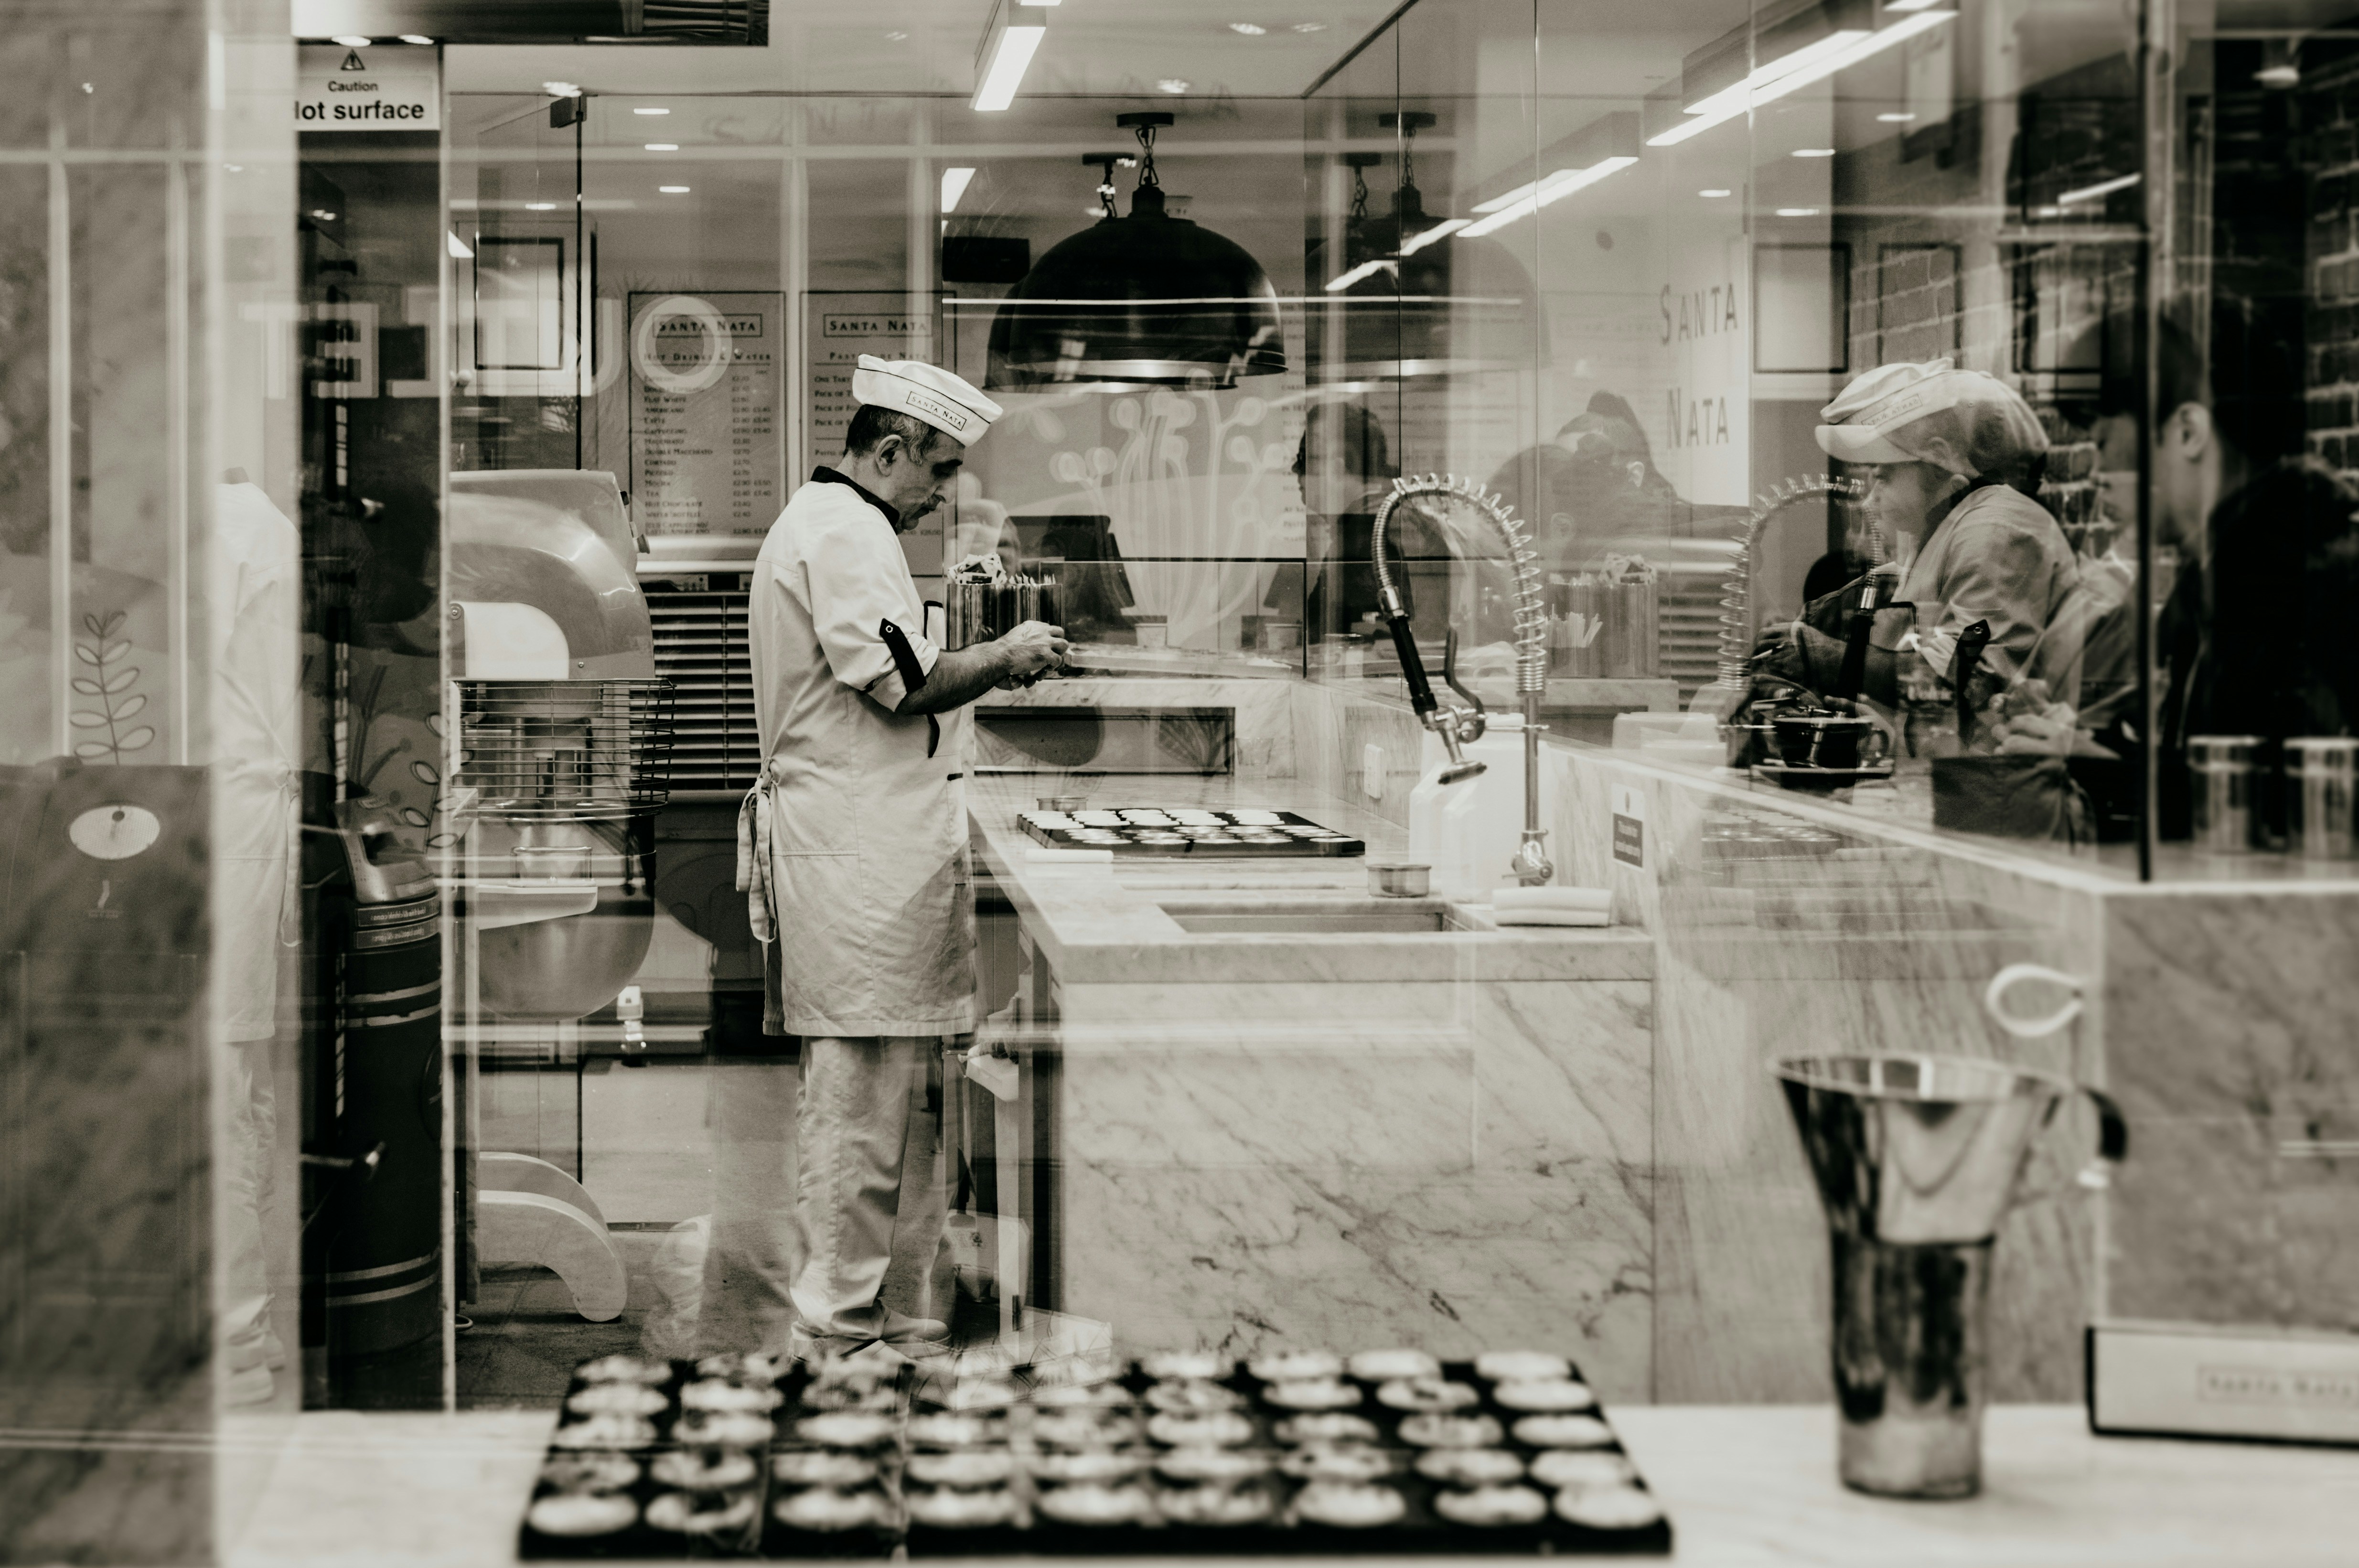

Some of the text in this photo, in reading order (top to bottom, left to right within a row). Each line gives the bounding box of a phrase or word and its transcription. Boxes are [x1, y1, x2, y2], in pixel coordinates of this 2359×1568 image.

[328, 80, 379, 92] Caution
[333, 100, 425, 119] surface
[1659, 283, 1738, 347] SANTA
[717, 321, 756, 332] NATA
[830, 321, 927, 331] SANTA NATA
[911, 397, 938, 412] SANTA
[943, 411, 961, 426] NATA
[1666, 387, 1729, 450] NATA
